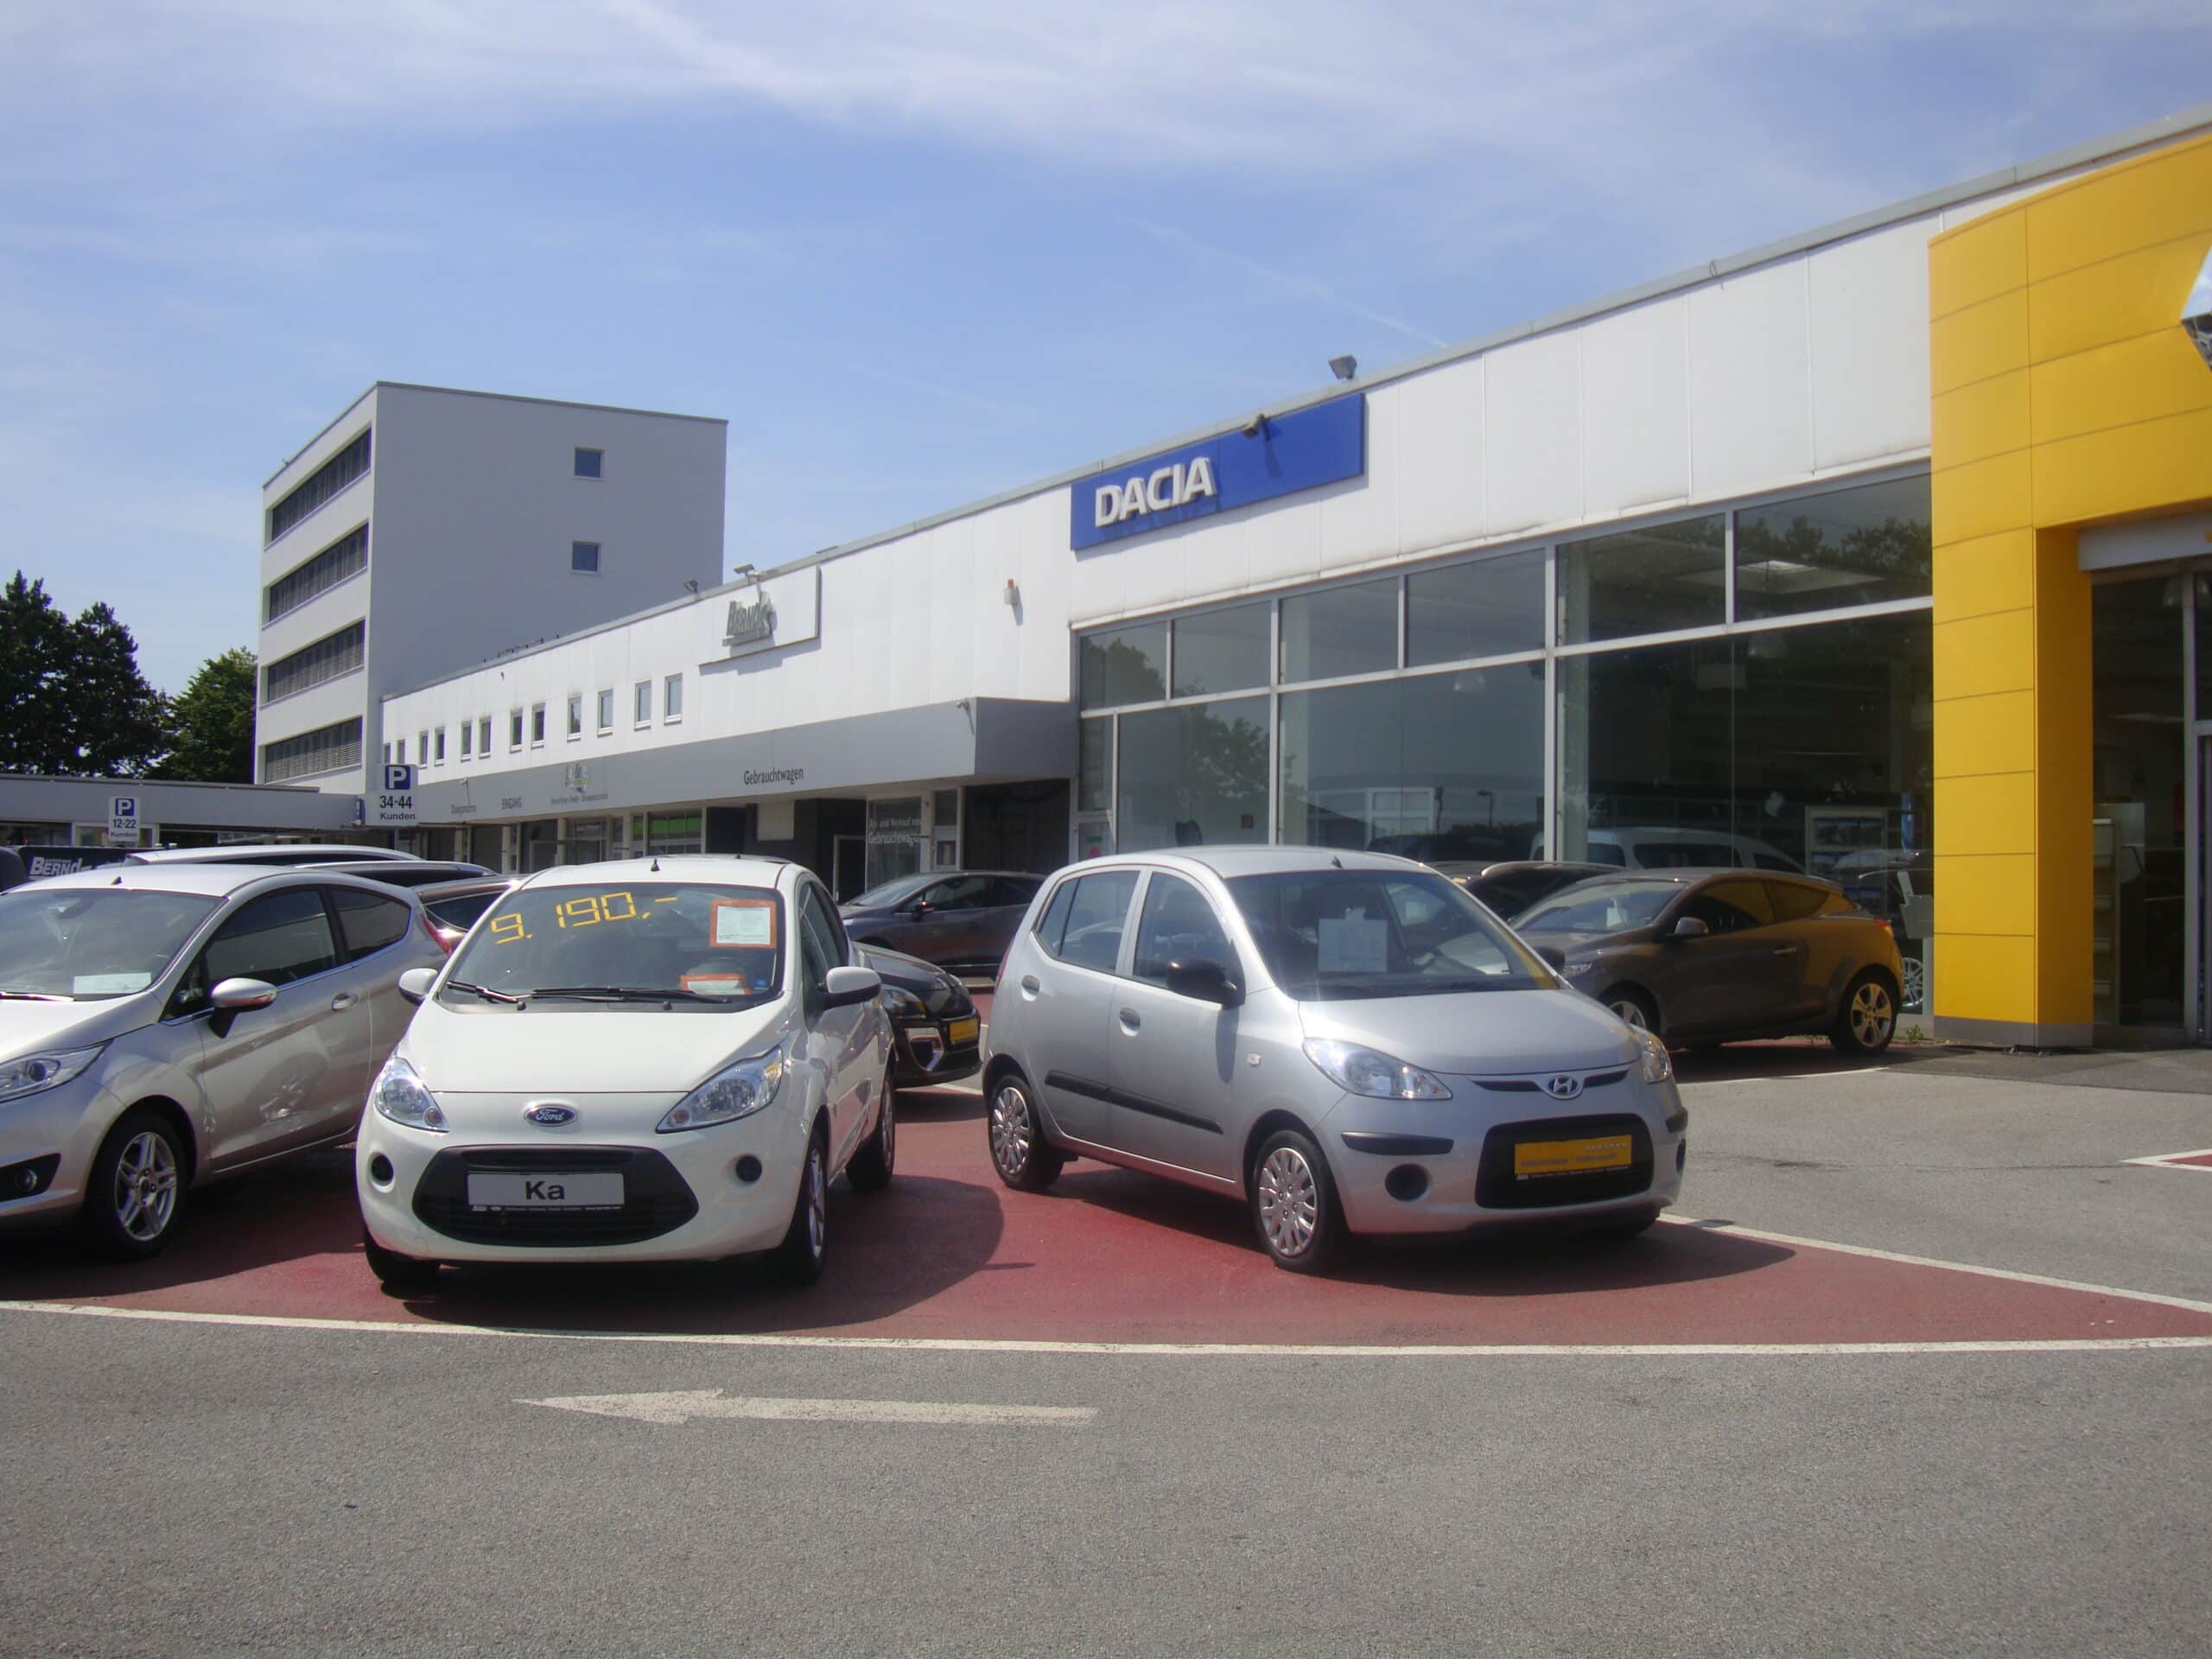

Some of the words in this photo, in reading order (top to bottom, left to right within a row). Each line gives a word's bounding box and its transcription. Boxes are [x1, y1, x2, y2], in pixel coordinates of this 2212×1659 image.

[1095, 456, 1217, 527] DACIA
[389, 766, 407, 789] P
[744, 767, 804, 785] Gebrauchtwagen
[118, 799, 131, 815] P
[380, 795, 412, 809] 34-44
[113, 819, 137, 829] 12-22
[29, 856, 92, 875] BERNd
[536, 1109, 564, 1121] Ford
[525, 1180, 565, 1200] Ka
